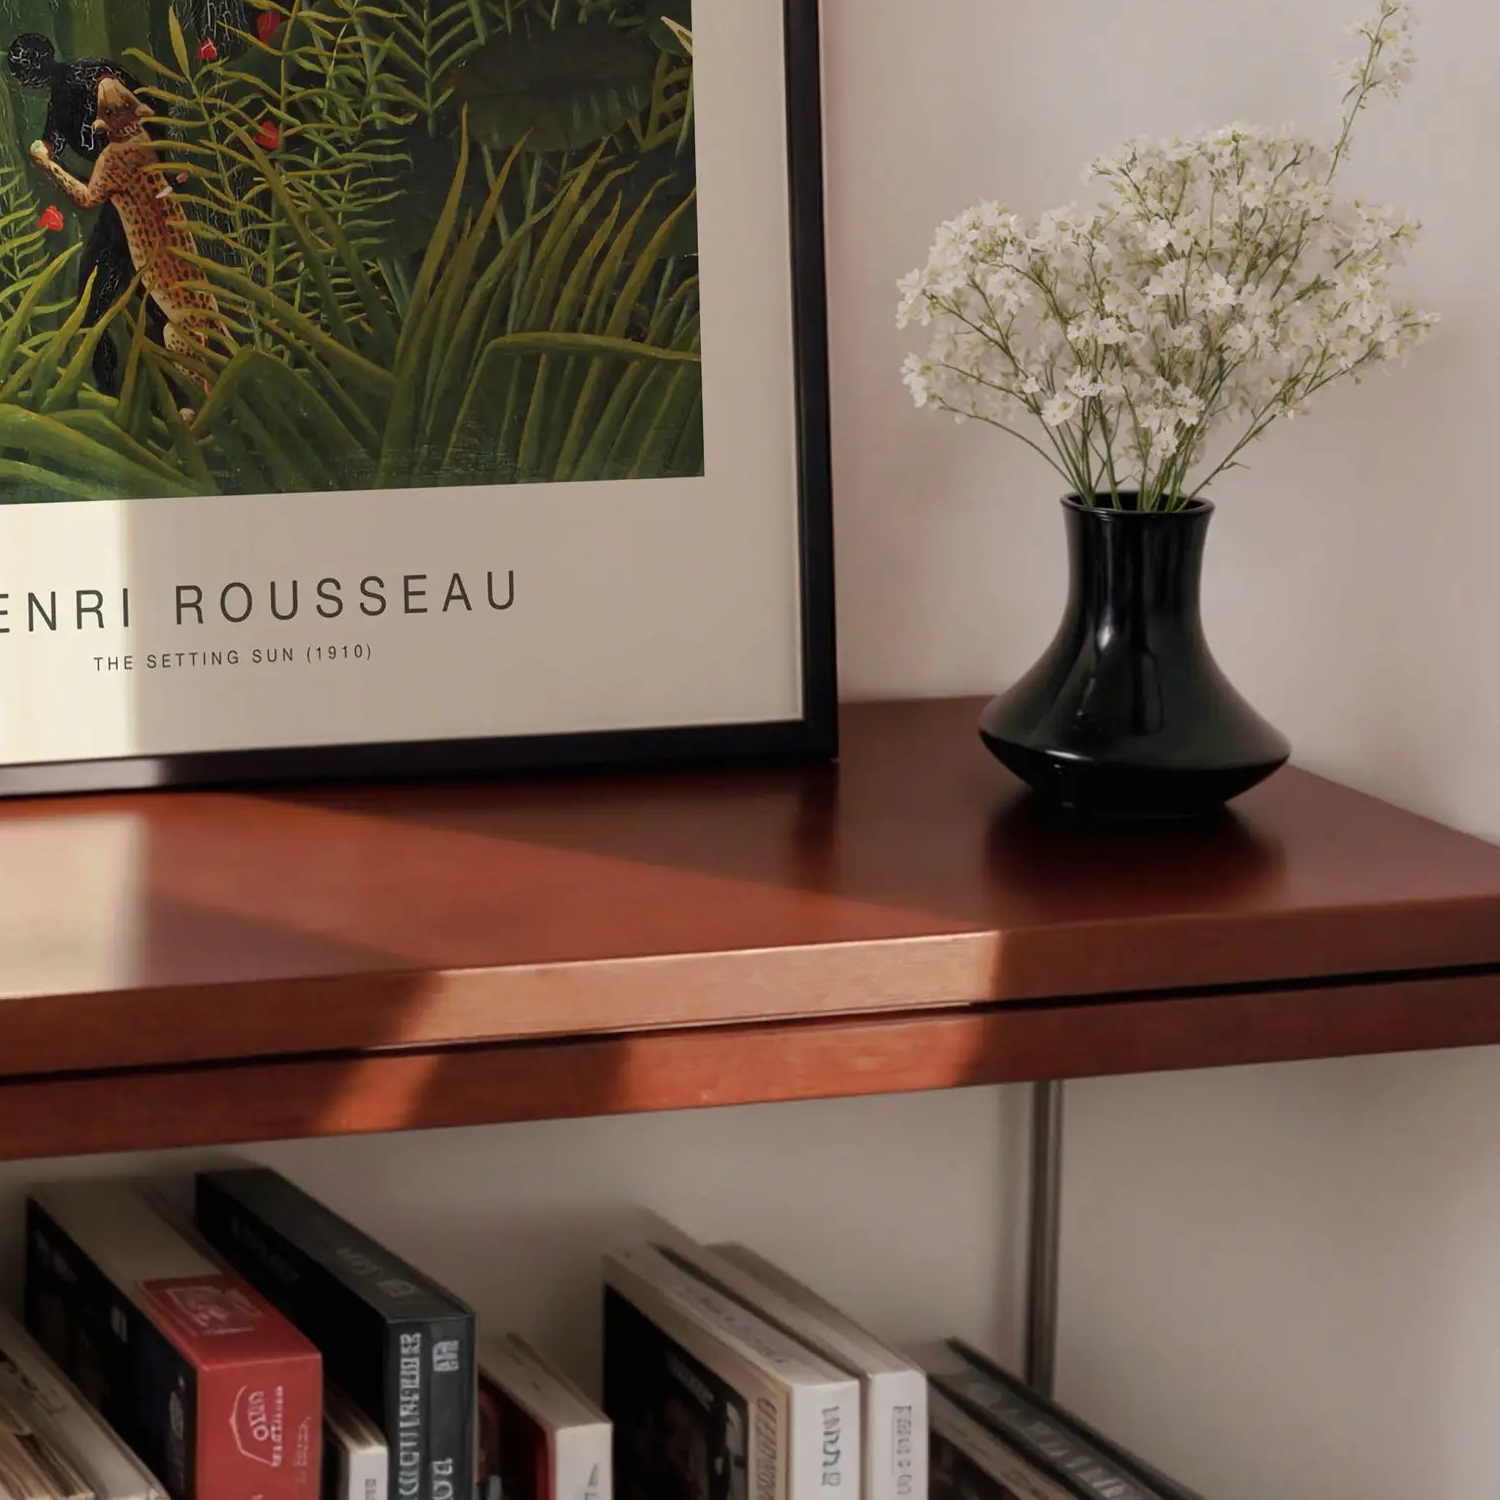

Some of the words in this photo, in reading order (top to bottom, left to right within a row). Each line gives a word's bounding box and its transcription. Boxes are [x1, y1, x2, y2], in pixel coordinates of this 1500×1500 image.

[175, 569, 515, 626] ROUSSEAU
[93, 656, 134, 672] THE
[146, 649, 239, 669] SETTING
[252, 647, 293, 664] SUN
[306, 643, 372, 664] (1910)
